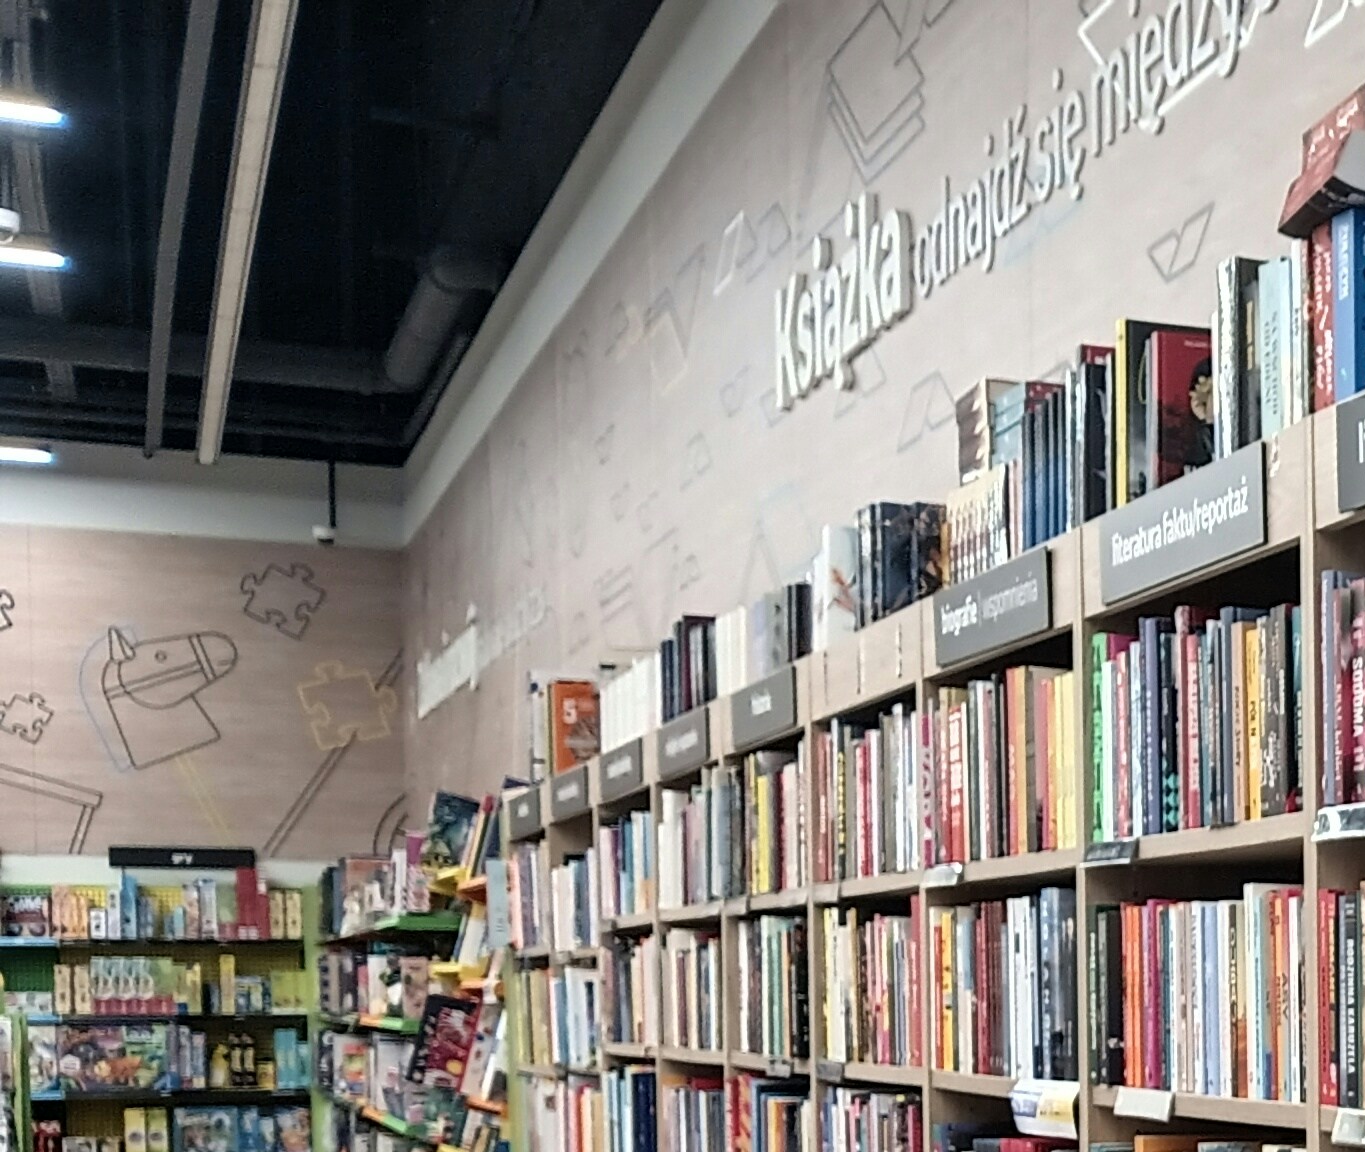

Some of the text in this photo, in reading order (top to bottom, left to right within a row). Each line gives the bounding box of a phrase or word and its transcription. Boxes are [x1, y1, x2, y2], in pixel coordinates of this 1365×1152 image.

[775, 191, 913, 410] Książka
[914, 104, 1030, 299] odnajdź
[1038, 69, 1085, 201] się
[1111, 474, 1249, 567] literatura faktu/reportaż
